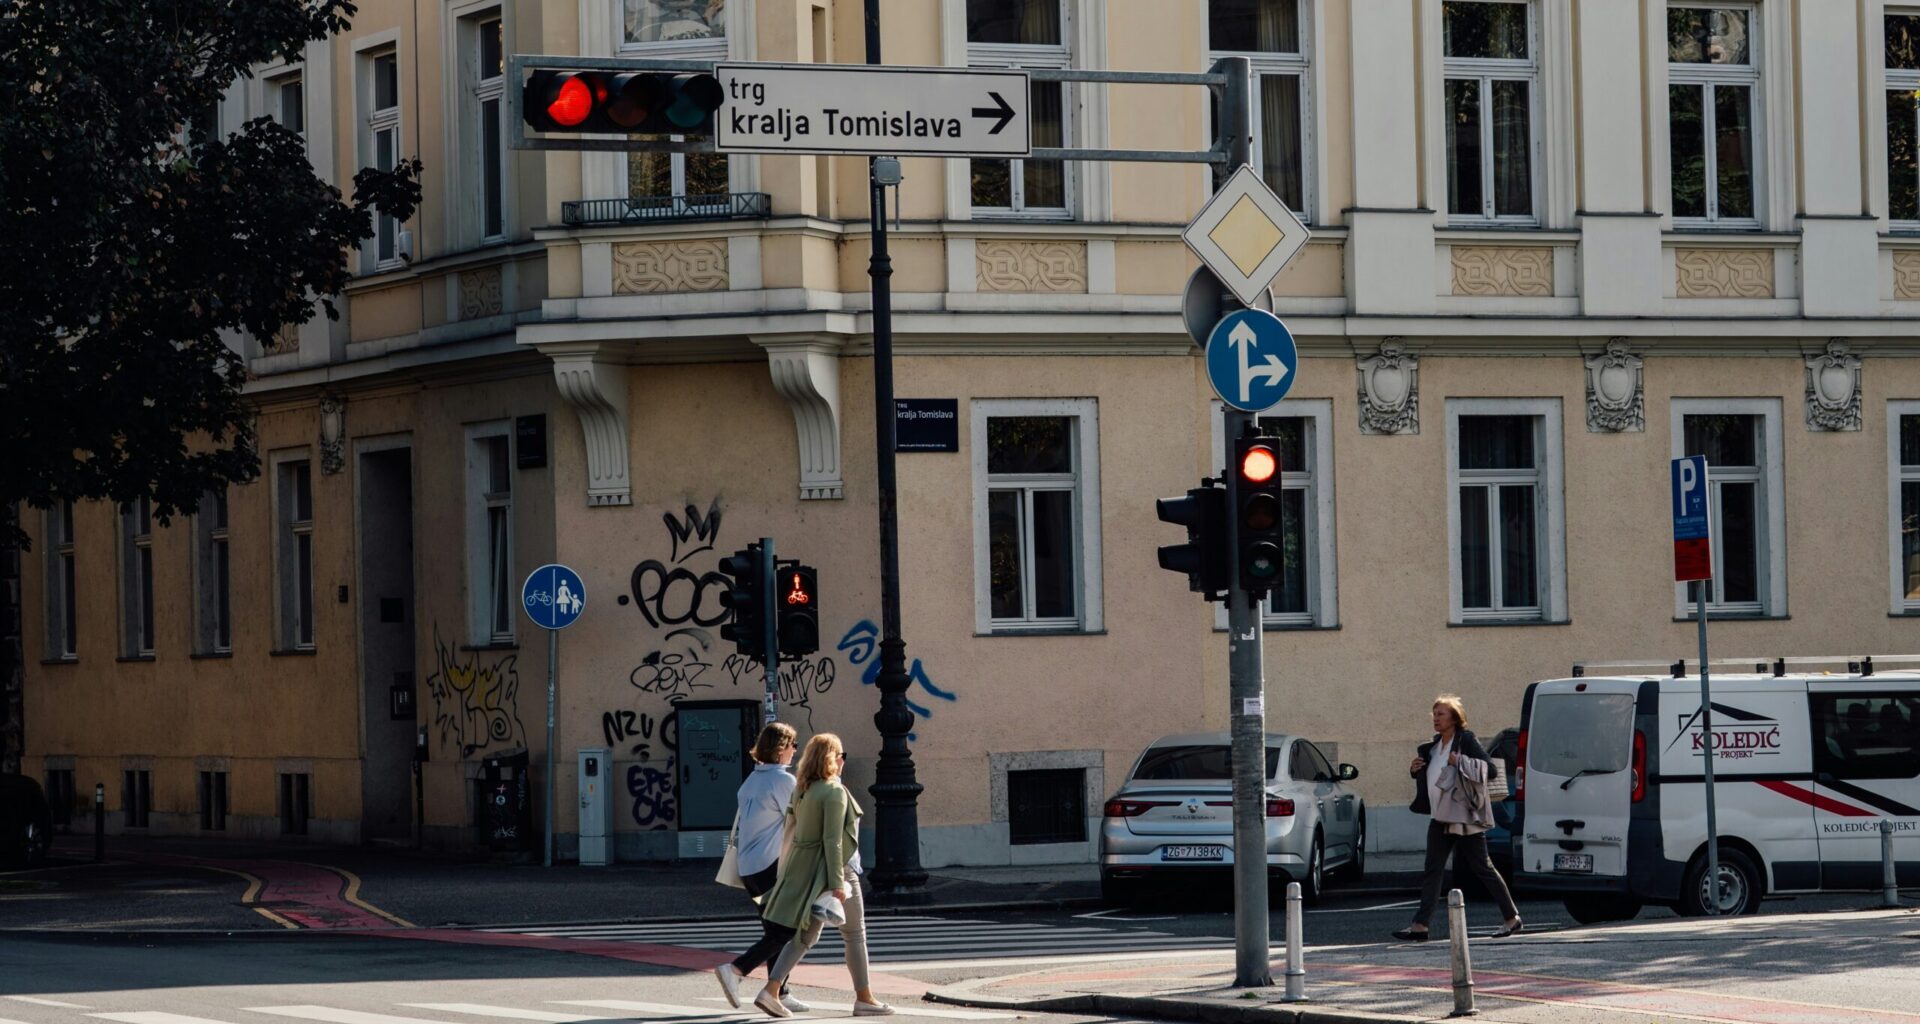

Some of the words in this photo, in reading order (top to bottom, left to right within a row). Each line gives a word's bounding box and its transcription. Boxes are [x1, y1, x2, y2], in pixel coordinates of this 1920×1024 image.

[730, 77, 765, 106] trg
[731, 106, 810, 142] kralja
[823, 108, 962, 138] Tomislava
[897, 410, 917, 420] kralja
[918, 410, 954, 419] Tomislava
[1680, 458, 1697, 516] P
[1691, 726, 1781, 750] KOLEDIĆ
[1720, 750, 1754, 759] PROJEKT
[1823, 821, 1918, 832] KOLEDIĆ-PJEKT
[1169, 847, 1181, 857] ZG
